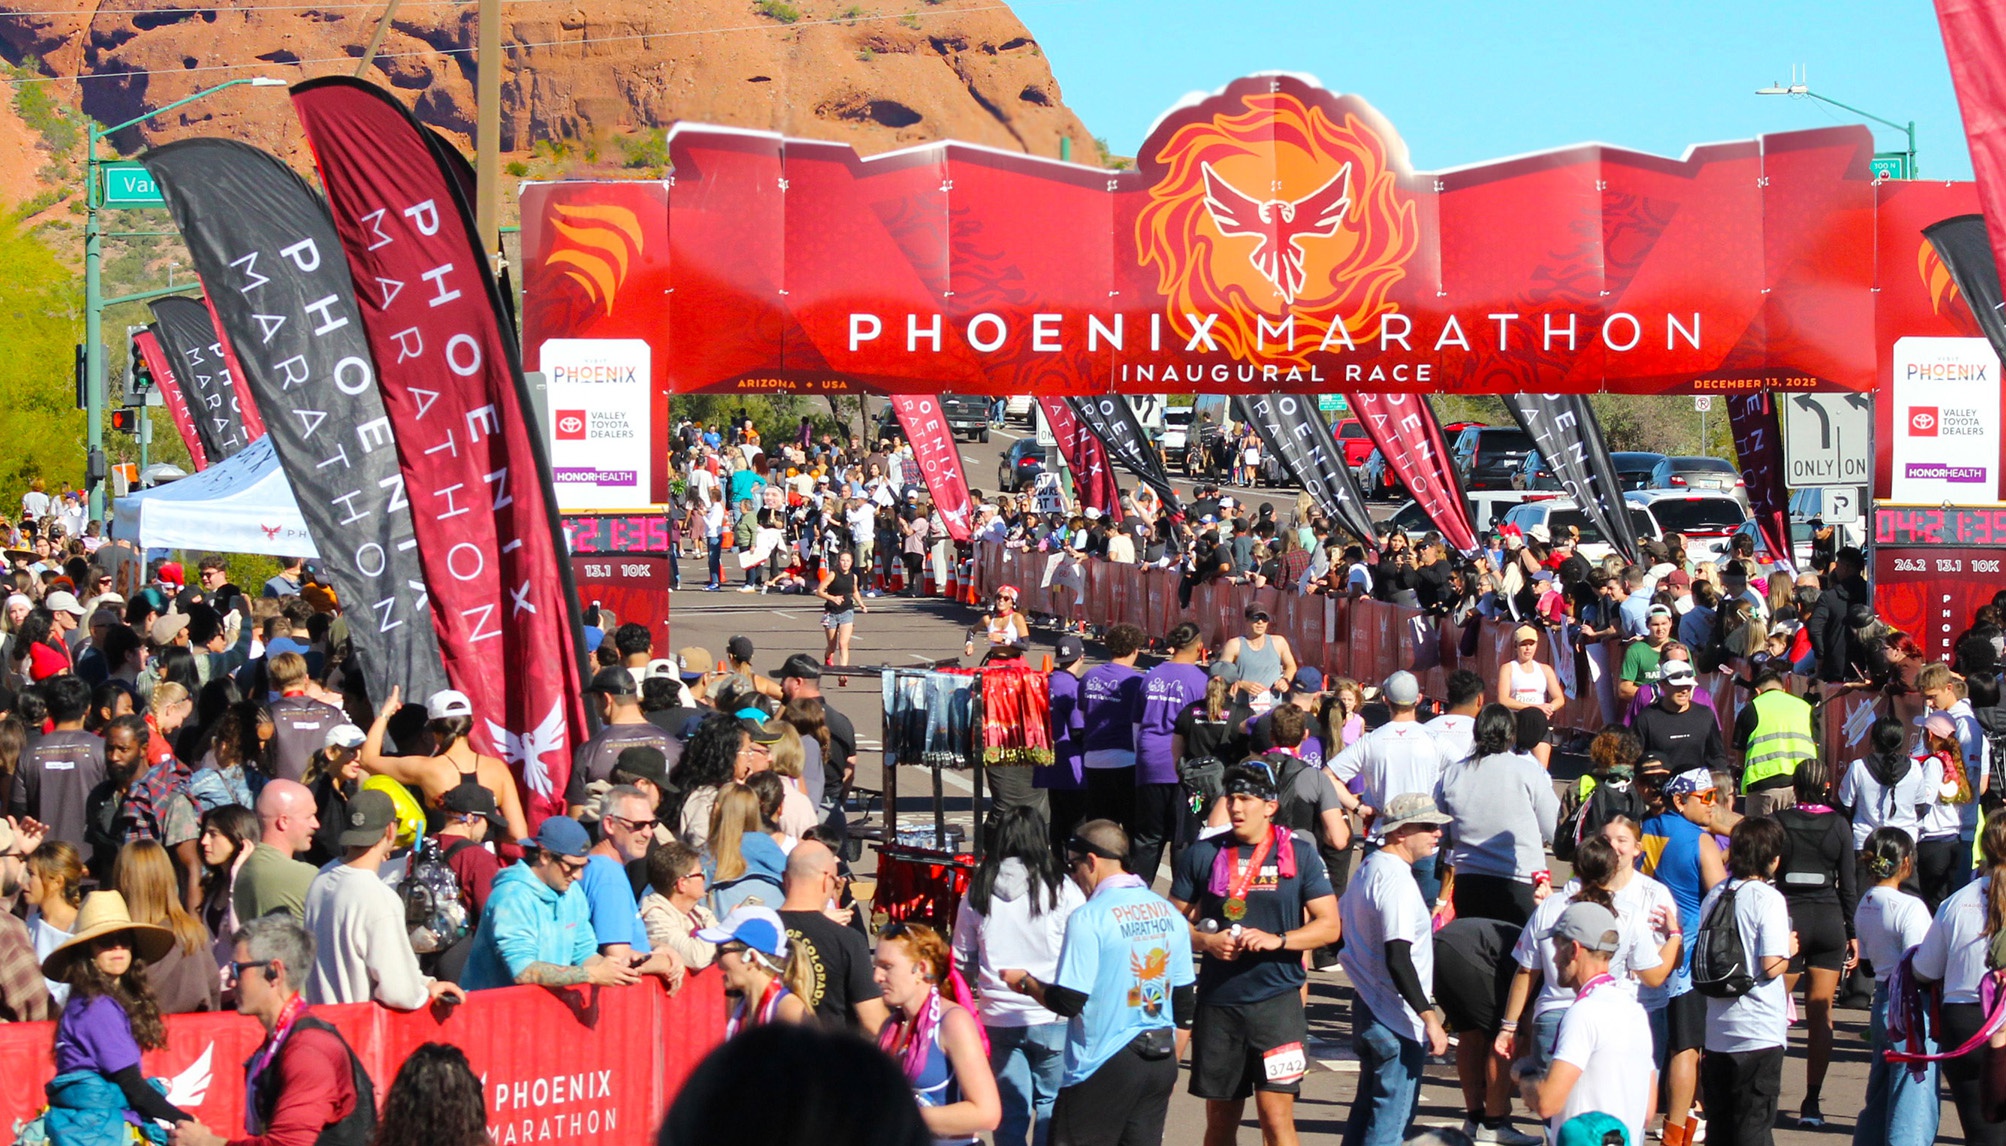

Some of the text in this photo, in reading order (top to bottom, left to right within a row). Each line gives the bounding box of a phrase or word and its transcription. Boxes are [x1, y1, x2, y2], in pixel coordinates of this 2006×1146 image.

[849, 312, 1702, 352] PHOENIX MARATHON
[554, 366, 636, 383] PHOENIX
[1122, 364, 1432, 383] INAUGURAL RACE
[1907, 364, 1986, 381] PHOENIX
[737, 379, 848, 389] ARIZONA USA
[1694, 380, 1761, 389] DECEMBER
[1786, 378, 1817, 387] 2025
[403, 198, 537, 621] PHOENIX
[1943, 409, 1977, 417] VALLEY
[361, 207, 502, 643] MARATHON
[1943, 418, 1979, 426] TOYOTA
[591, 430, 634, 438] DEALERS
[1942, 427, 1984, 435] DEALERS
[230, 251, 403, 633] MARATHON
[903, 400, 944, 489] RATHON
[919, 401, 957, 481] OENIX
[1279, 396, 1350, 503] OENIX
[1794, 460, 1834, 476] ONLY
[1909, 468, 1981, 478] HONORHEALTH
[557, 472, 633, 482] HONORHEALTH
[584, 564, 651, 577] 13.1 10K
[1894, 559, 1999, 572] 26.2 13.1 10K
[1112, 902, 1172, 923] PHOENIX
[786, 929, 803, 938] OF
[1120, 918, 1175, 939] MARATHON
[1269, 1060, 1303, 1076] 3742
[496, 1070, 611, 1112] PHOENIX
[486, 1107, 617, 1145] MARATHON
